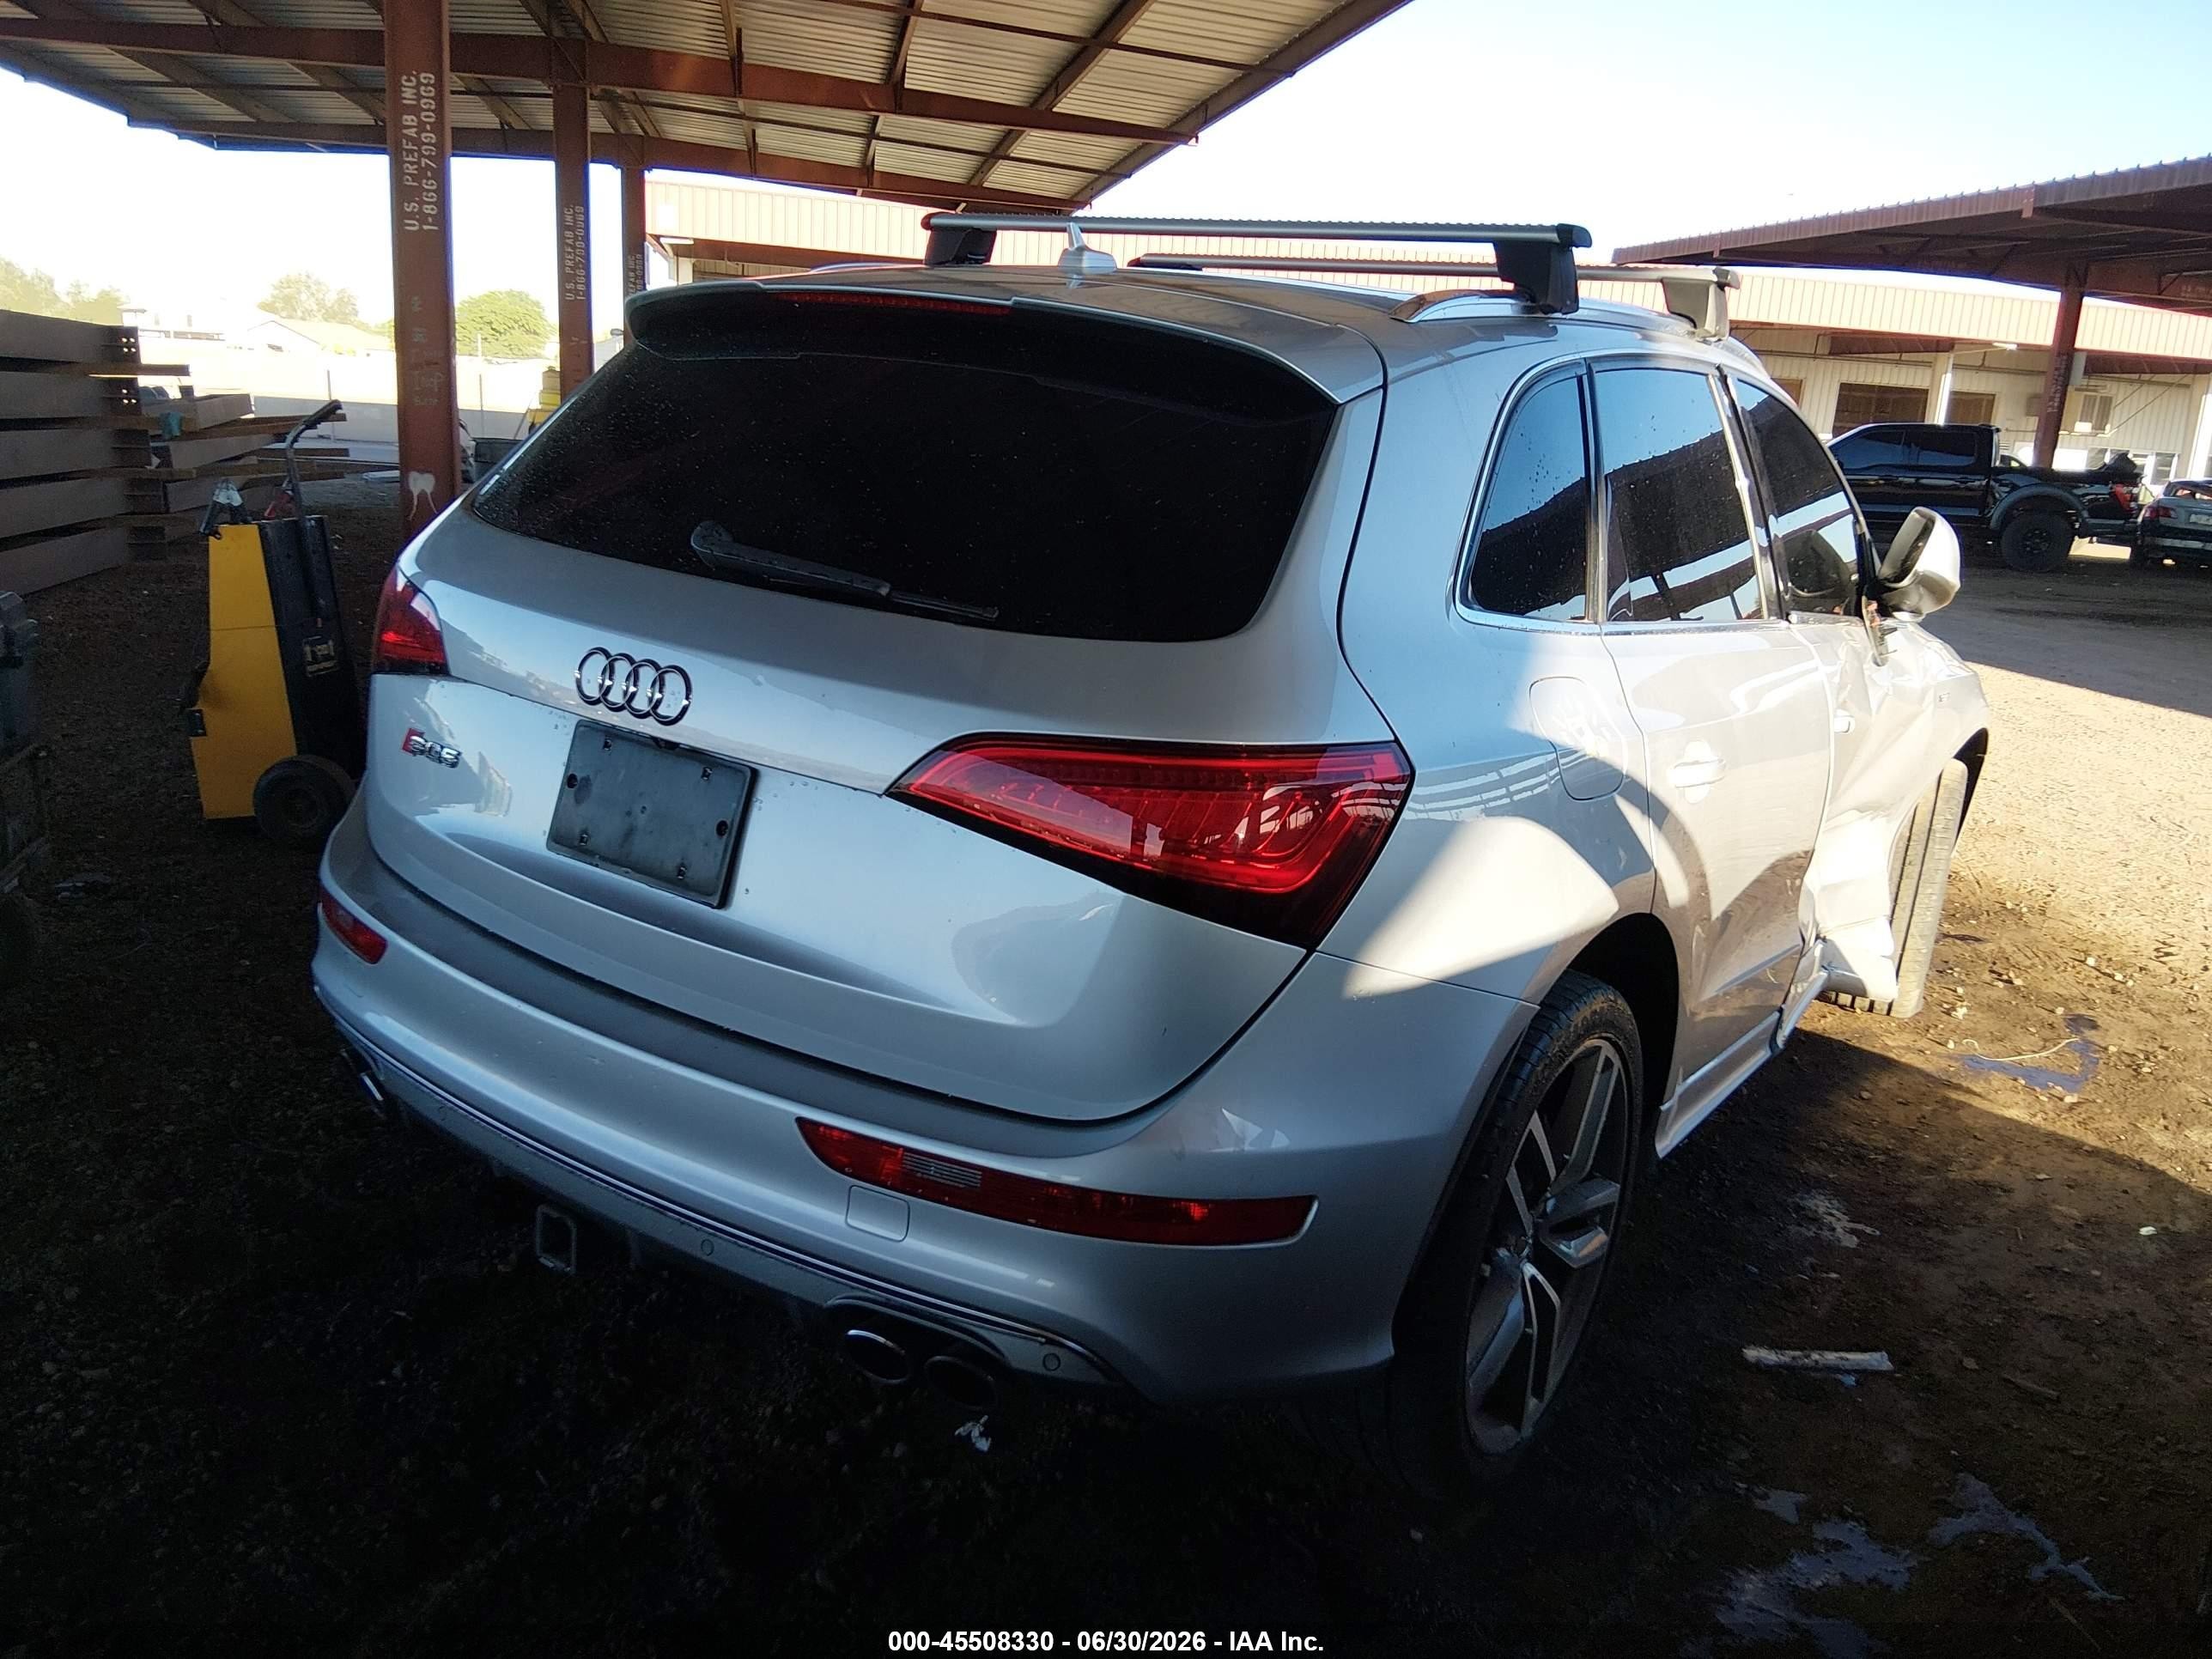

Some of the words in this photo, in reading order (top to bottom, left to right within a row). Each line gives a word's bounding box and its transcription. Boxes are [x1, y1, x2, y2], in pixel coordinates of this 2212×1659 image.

[401, 70, 418, 106] INC.
[402, 114, 419, 186] PREFAB
[419, 72, 440, 232] 1-866-799-0969
[403, 197, 420, 232] U.S.
[563, 204, 574, 226] INC.
[563, 230, 575, 274] PREFAB
[564, 279, 575, 301] U.S.
